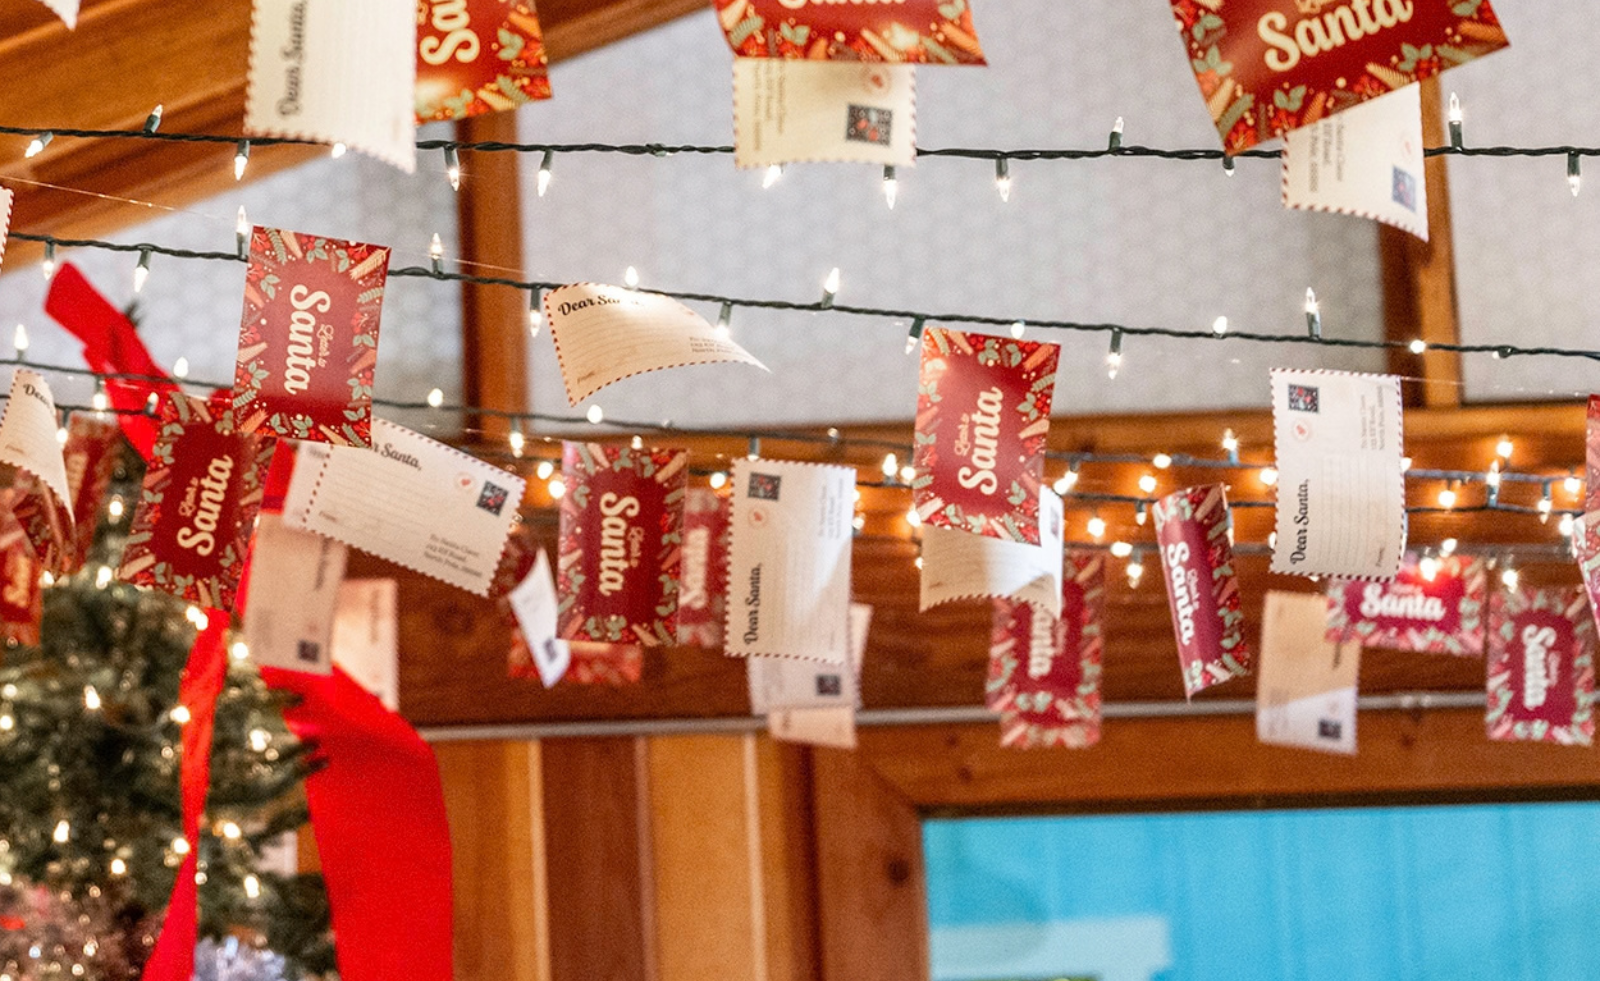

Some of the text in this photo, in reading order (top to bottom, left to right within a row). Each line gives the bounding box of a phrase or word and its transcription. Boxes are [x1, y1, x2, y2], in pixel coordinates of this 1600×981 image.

[284, 284, 331, 395] Santa
[557, 295, 596, 317] Dear
[379, 441, 422, 472] Santa,
[958, 386, 1004, 495] Santa
[177, 454, 234, 556] Santa
[599, 492, 640, 597] Santa
[1289, 477, 1311, 565] Dear Santa,
[743, 561, 762, 645] Dear Santa,
[1166, 541, 1195, 646] Santa
[1361, 582, 1447, 621] Santa
